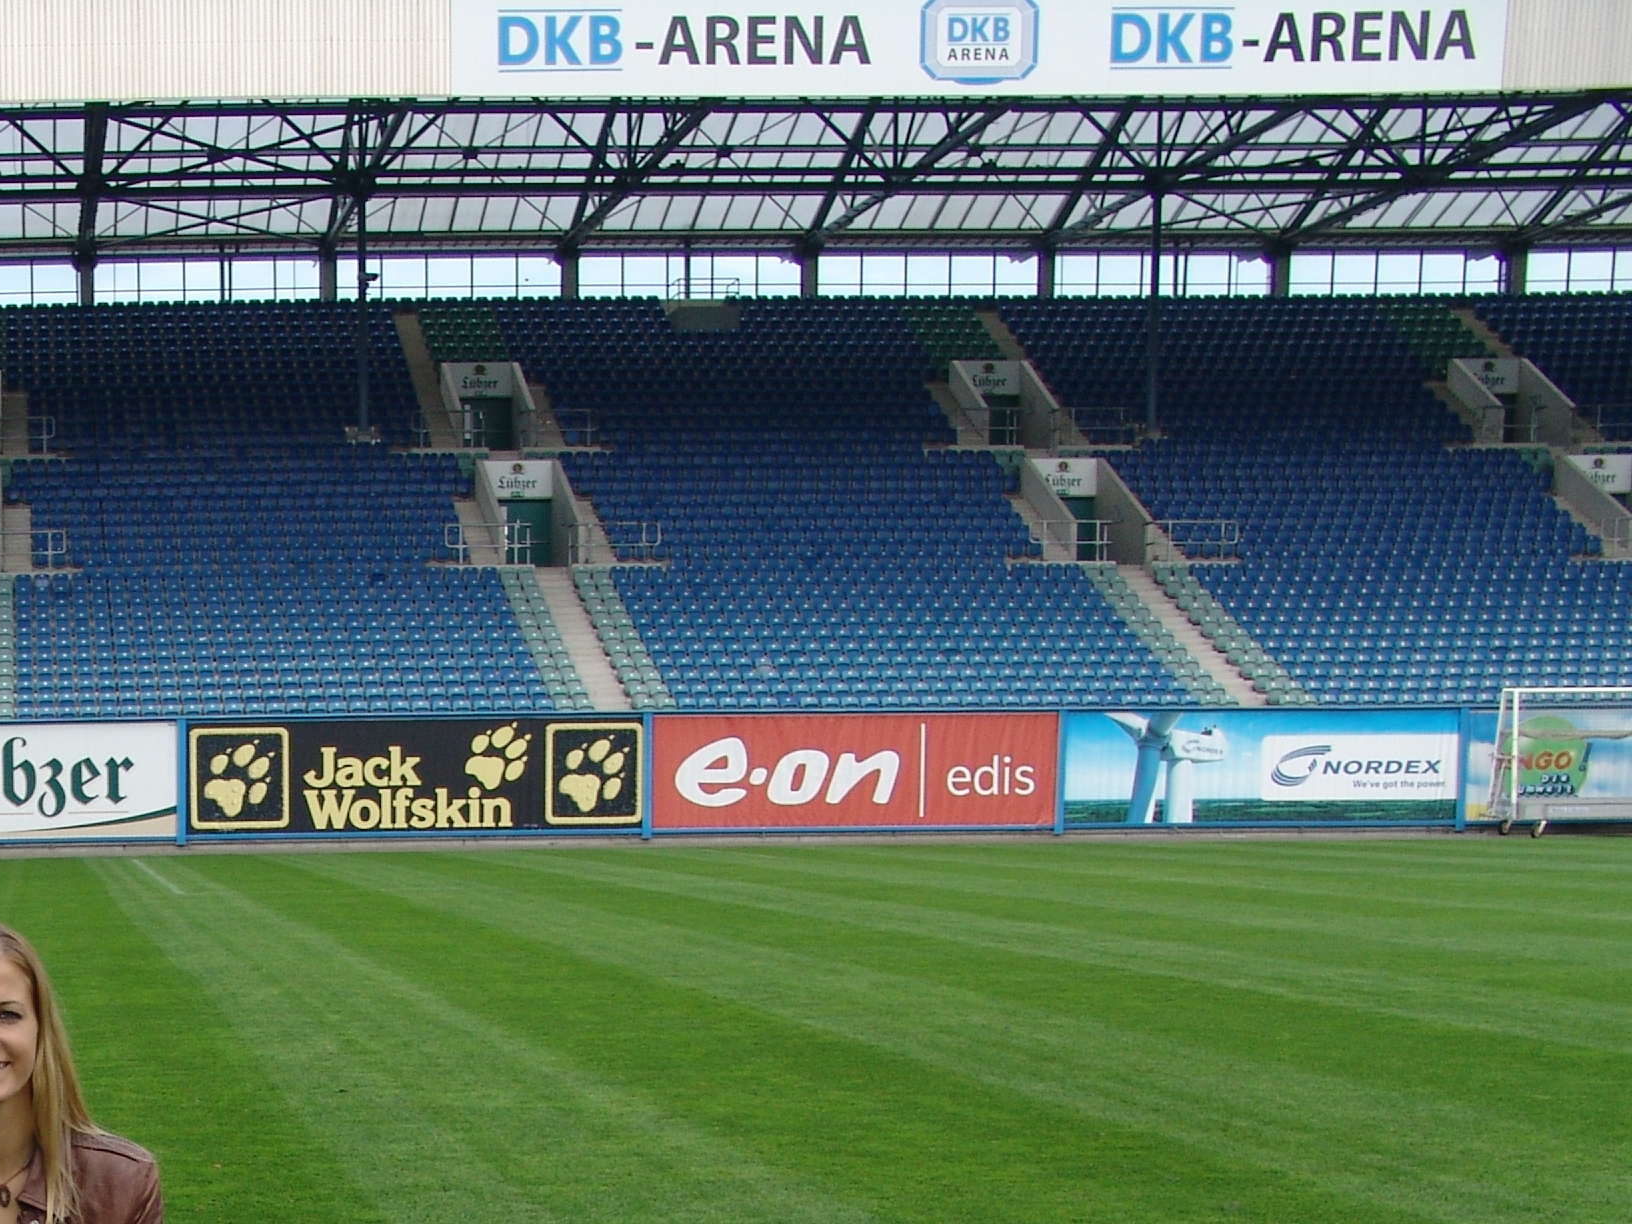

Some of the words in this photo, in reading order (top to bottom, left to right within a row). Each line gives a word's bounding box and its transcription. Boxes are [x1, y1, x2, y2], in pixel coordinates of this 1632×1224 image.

[947, 17, 1009, 42] DKB
[947, 48, 1009, 61] ARENA
[497, 476, 537, 490] Lübzer
[303, 746, 422, 788] Jack
[945, 755, 1036, 796] edis
[1322, 760, 1440, 774] NORDEX
[1382, 780, 1398, 790] got
[1400, 780, 1414, 788] the
[303, 786, 514, 830] Wolfskin
